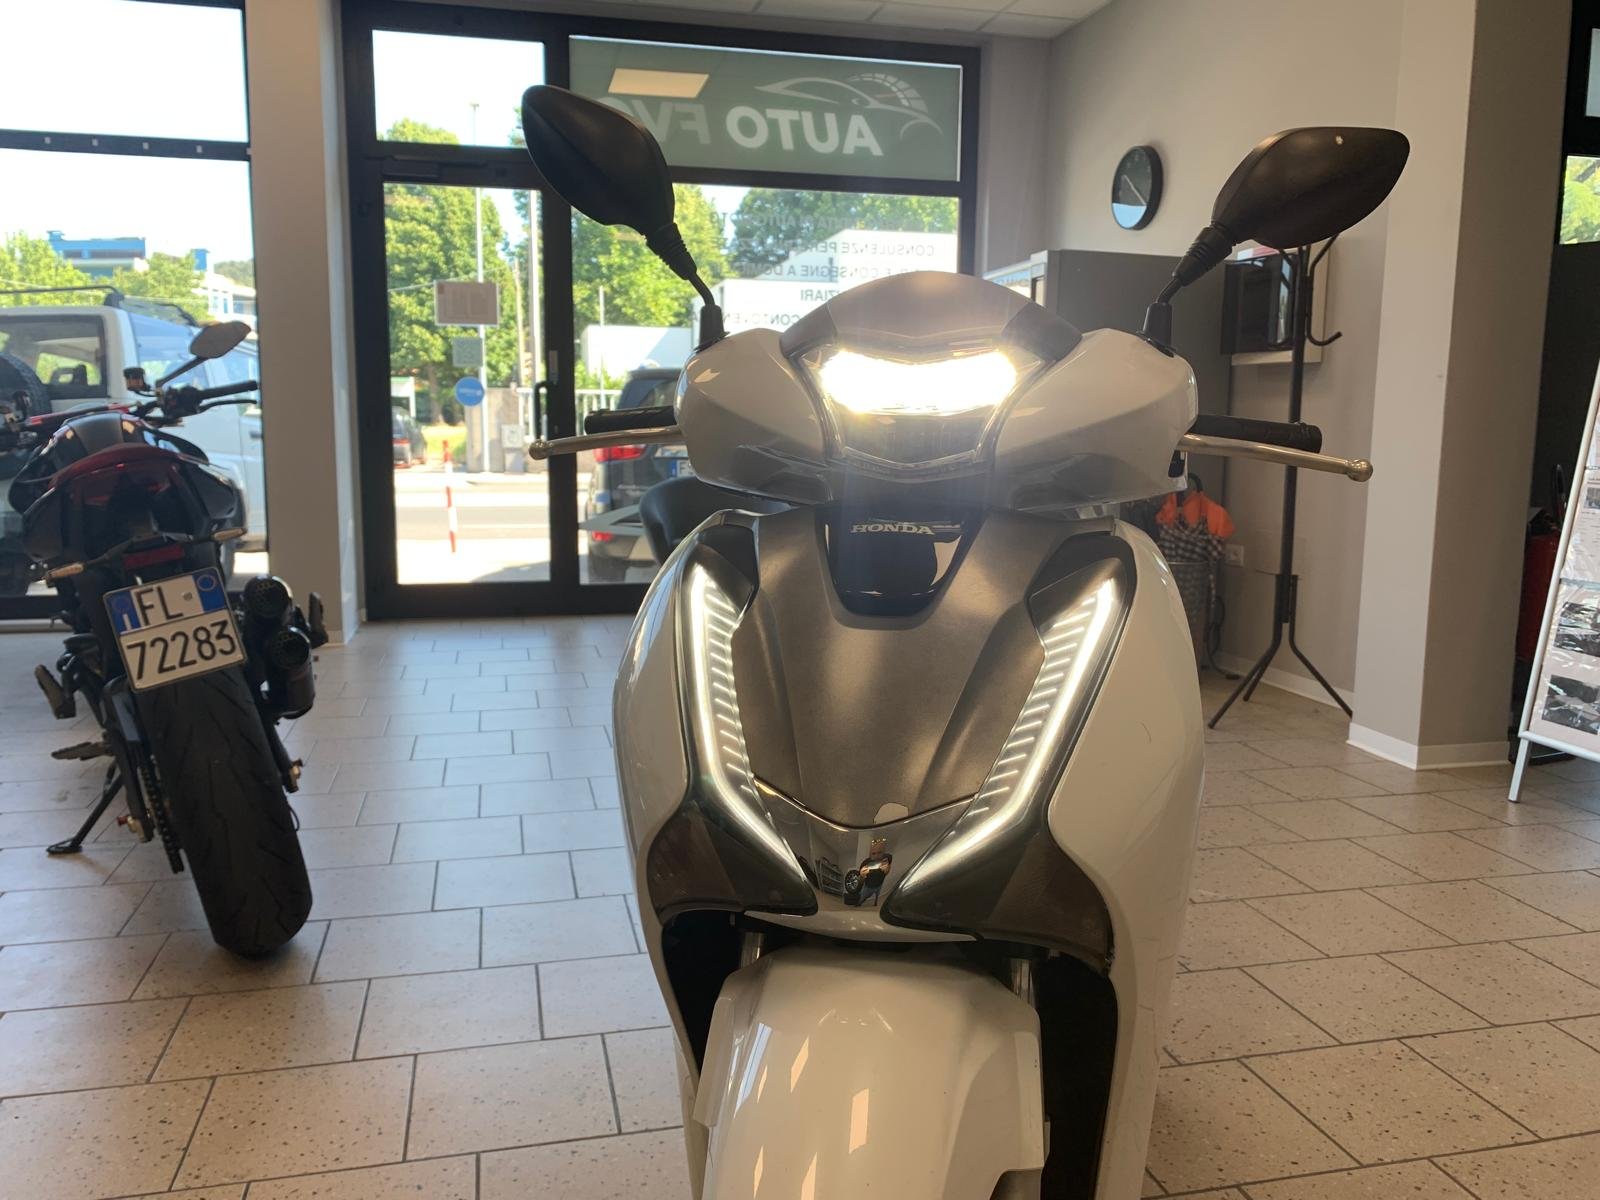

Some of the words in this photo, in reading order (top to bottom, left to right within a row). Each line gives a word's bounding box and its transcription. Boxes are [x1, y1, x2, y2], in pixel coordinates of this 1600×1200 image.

[850, 523, 935, 535] HONDA
[135, 585, 184, 626] FL
[126, 619, 237, 681] 72283
